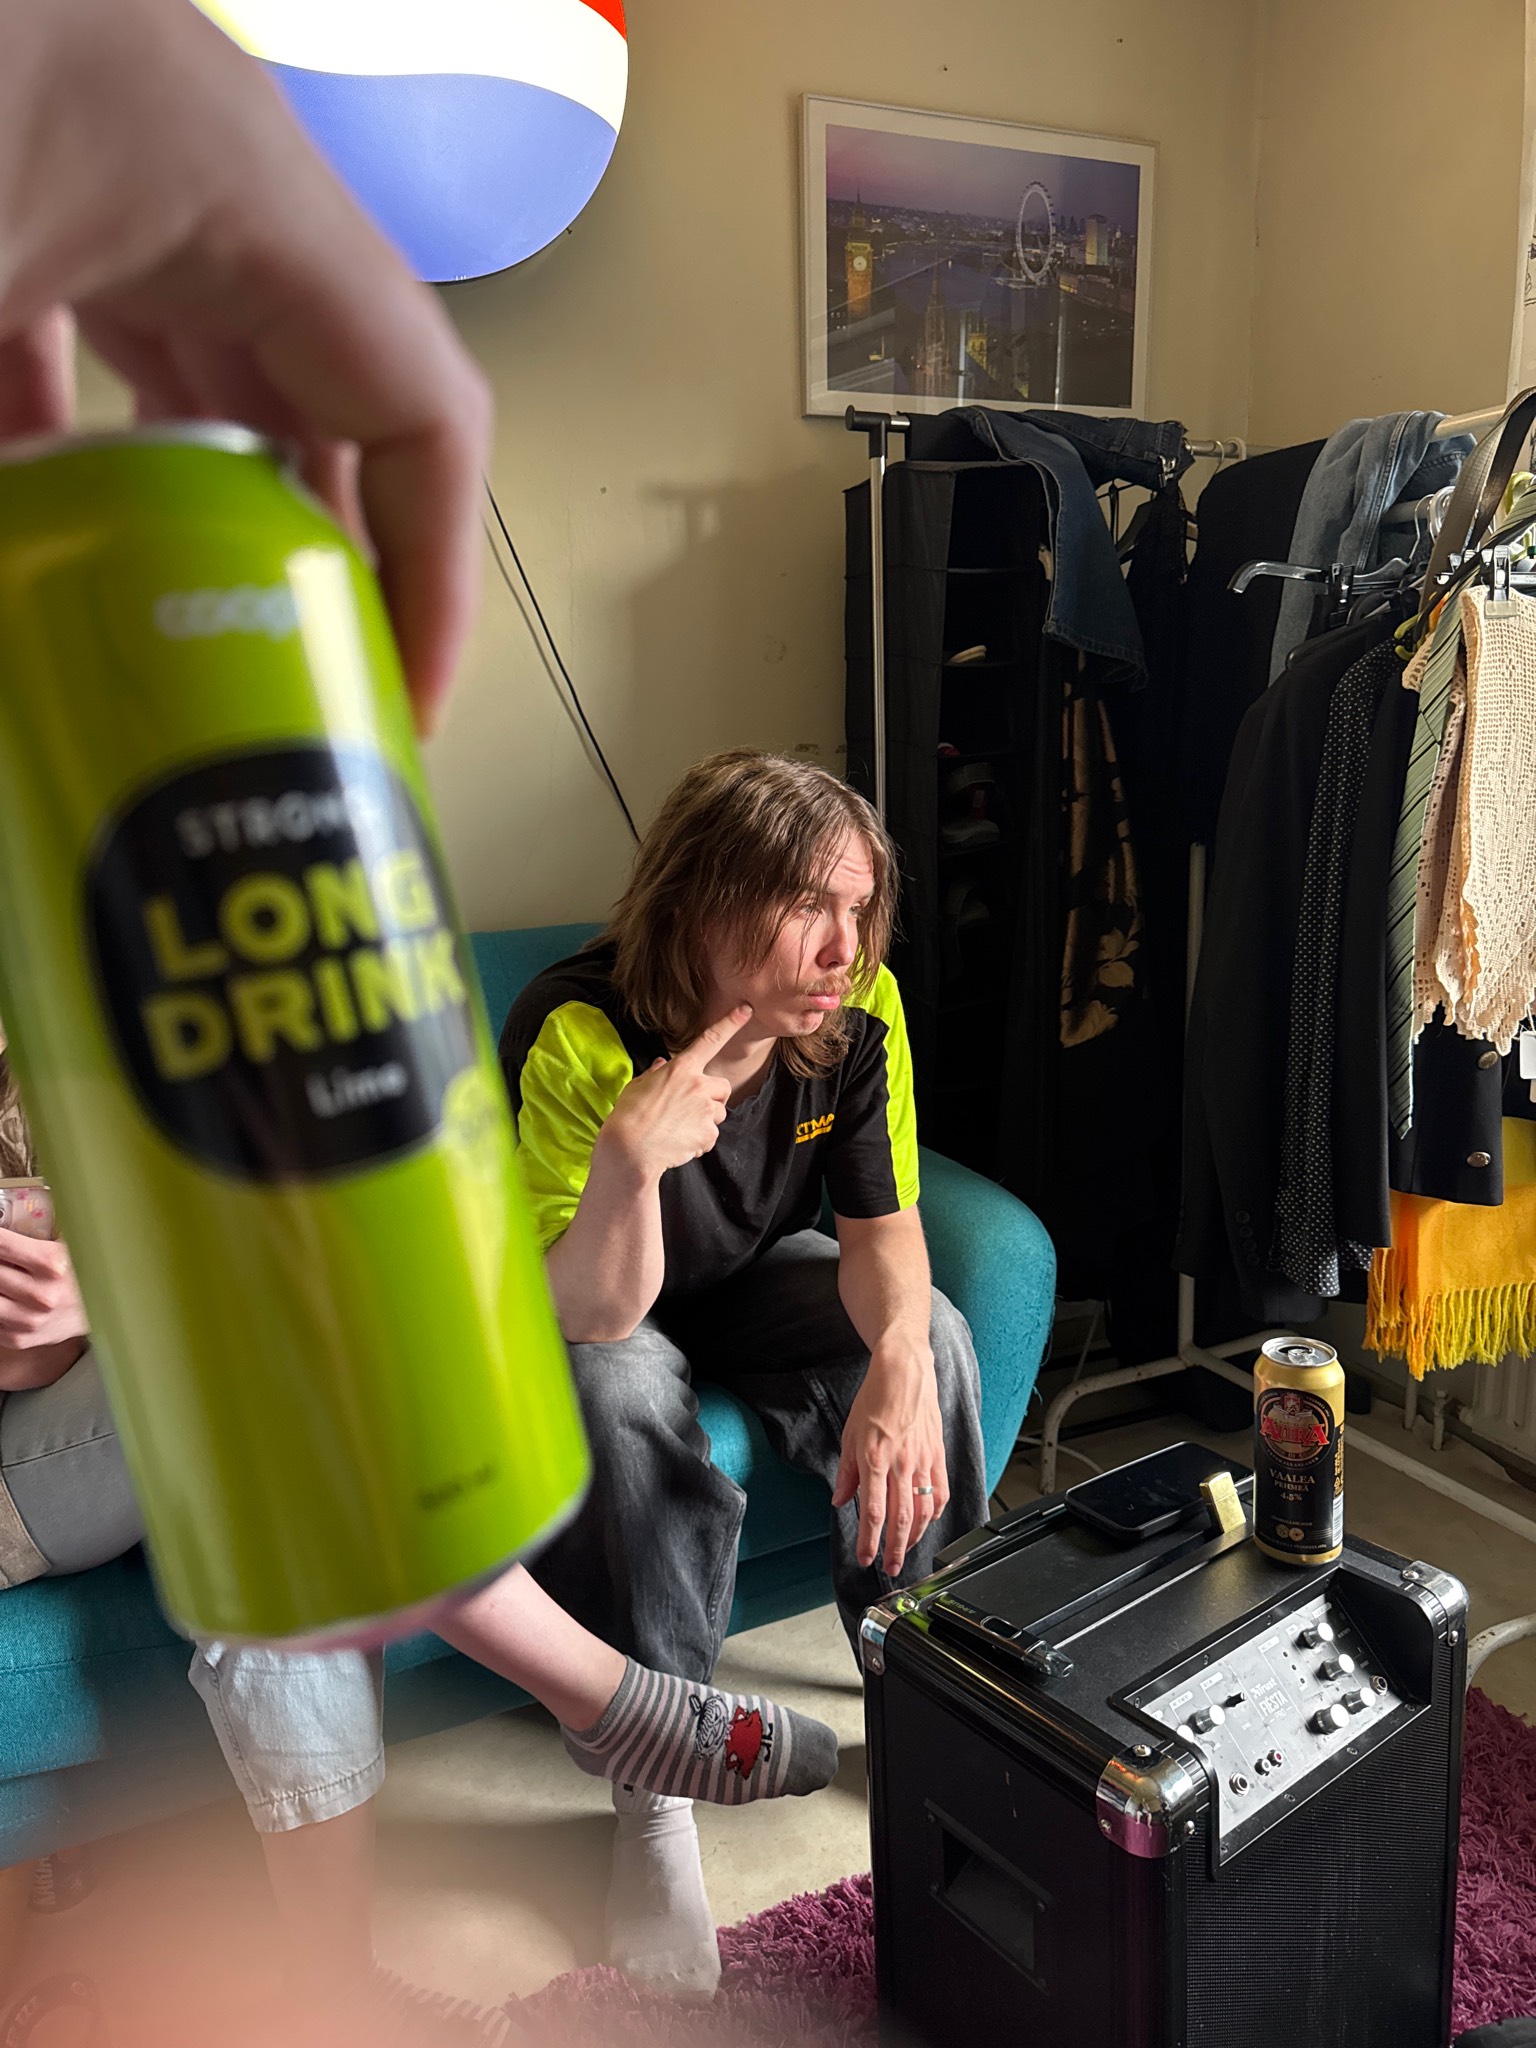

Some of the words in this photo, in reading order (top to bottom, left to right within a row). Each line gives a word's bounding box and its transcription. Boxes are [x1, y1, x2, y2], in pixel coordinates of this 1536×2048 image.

[174, 790, 374, 857] STRON
[146, 850, 438, 983] LONG
[142, 928, 466, 1082] DRINK
[304, 1061, 406, 1119] Lime
[1260, 1414, 1330, 1447] AURA
[1269, 1467, 1316, 1484] VAALEA
[1255, 1677, 1277, 1696] Trust
